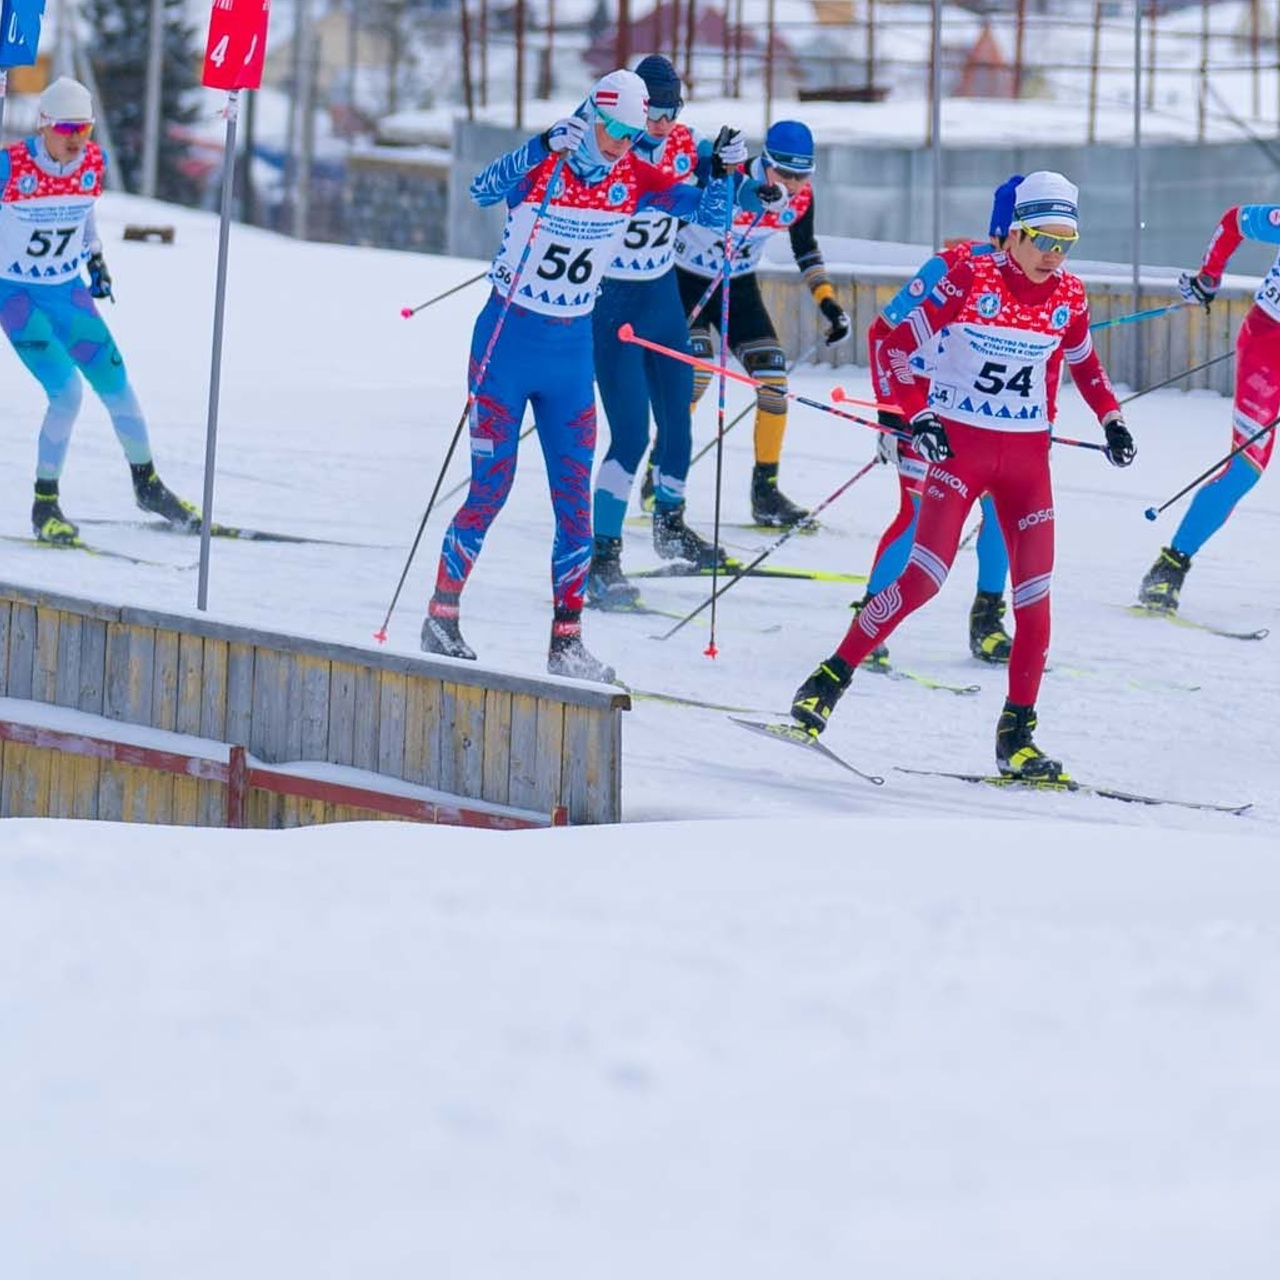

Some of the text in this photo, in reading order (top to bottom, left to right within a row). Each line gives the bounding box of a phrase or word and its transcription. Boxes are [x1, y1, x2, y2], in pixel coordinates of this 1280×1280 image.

[26, 226, 79, 258] 57
[623, 217, 672, 249] 52
[495, 266, 511, 285] 56
[536, 243, 594, 285] 56
[973, 361, 1034, 397] 54
